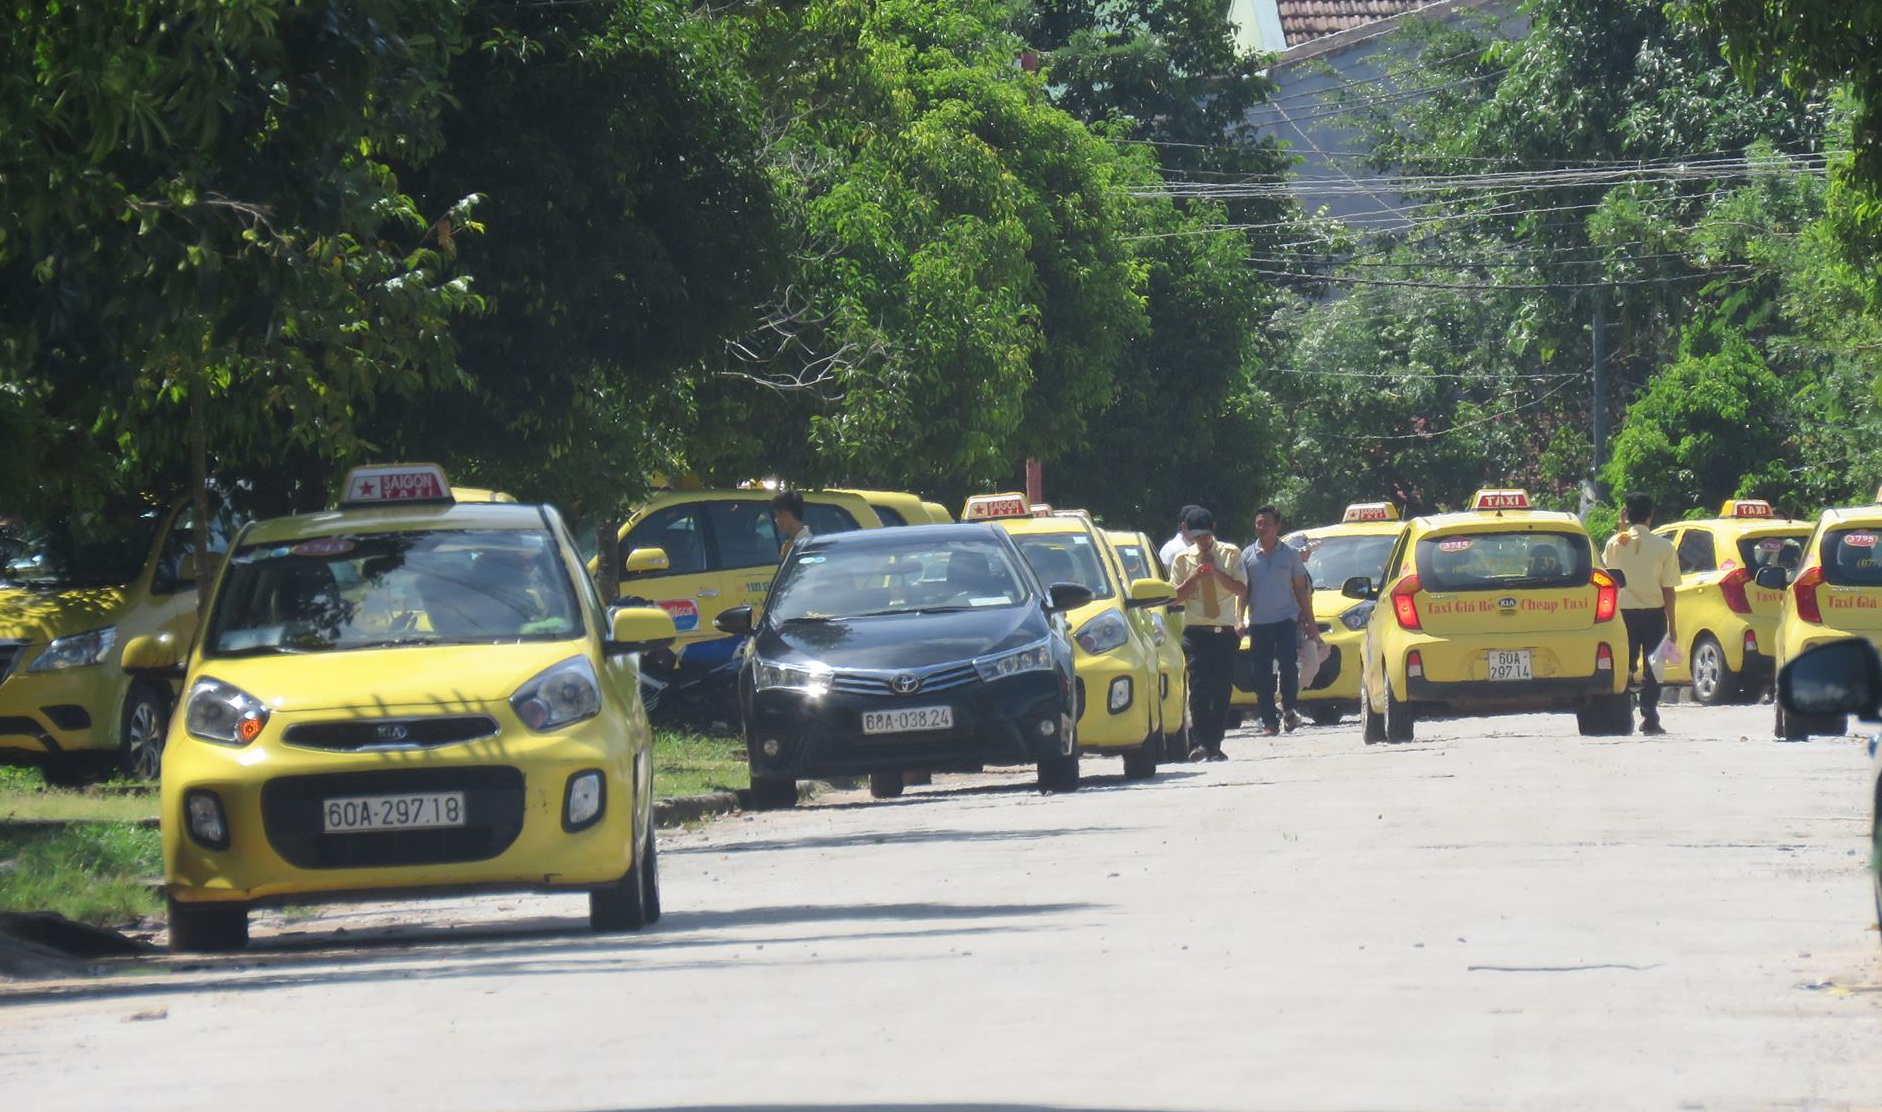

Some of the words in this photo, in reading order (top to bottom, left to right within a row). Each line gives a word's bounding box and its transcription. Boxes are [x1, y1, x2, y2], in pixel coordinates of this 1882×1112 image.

[384, 474, 432, 489] SAIGON
[989, 500, 1019, 510] SAIGON
[1485, 496, 1519, 505] TAXI
[1741, 504, 1766, 515] TAXI
[1500, 599, 1515, 607] KIA
[1521, 598, 1558, 613] Cheap
[1563, 597, 1588, 609] Taxi
[1828, 595, 1853, 608] Taxi
[1426, 602, 1451, 614] Taxi
[1499, 653, 1521, 665] 60A
[377, 726, 402, 738] KIA
[328, 797, 459, 827] 60A-297.18
